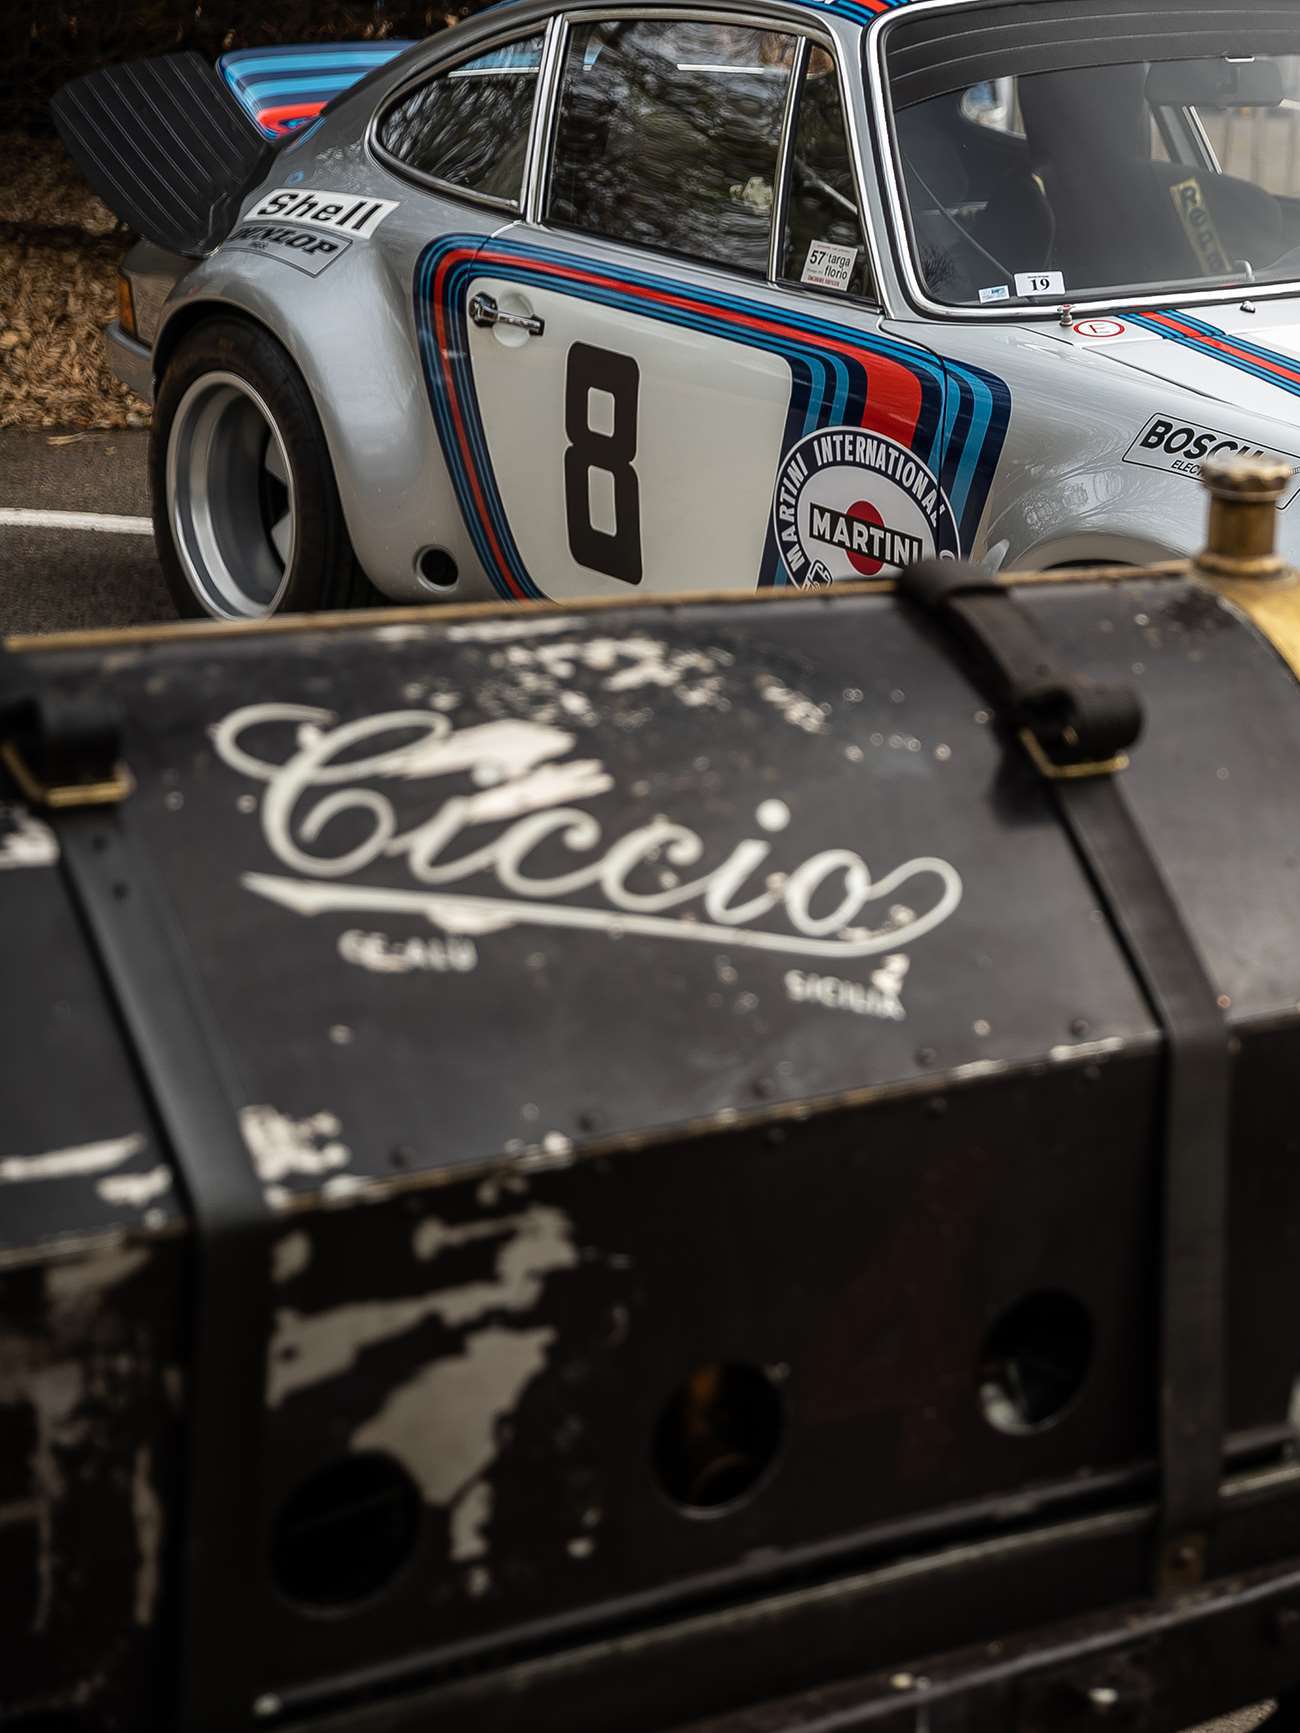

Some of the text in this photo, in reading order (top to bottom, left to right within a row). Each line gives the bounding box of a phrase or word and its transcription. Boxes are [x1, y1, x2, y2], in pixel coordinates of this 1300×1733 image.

[257, 193, 383, 230] Shell
[828, 253, 851, 268] targa
[1031, 278, 1050, 291] 19
[564, 340, 643, 586] 8
[780, 453, 809, 573] MARTINI
[813, 508, 919, 567] MARTINI
[211, 703, 962, 945] Ciccio
